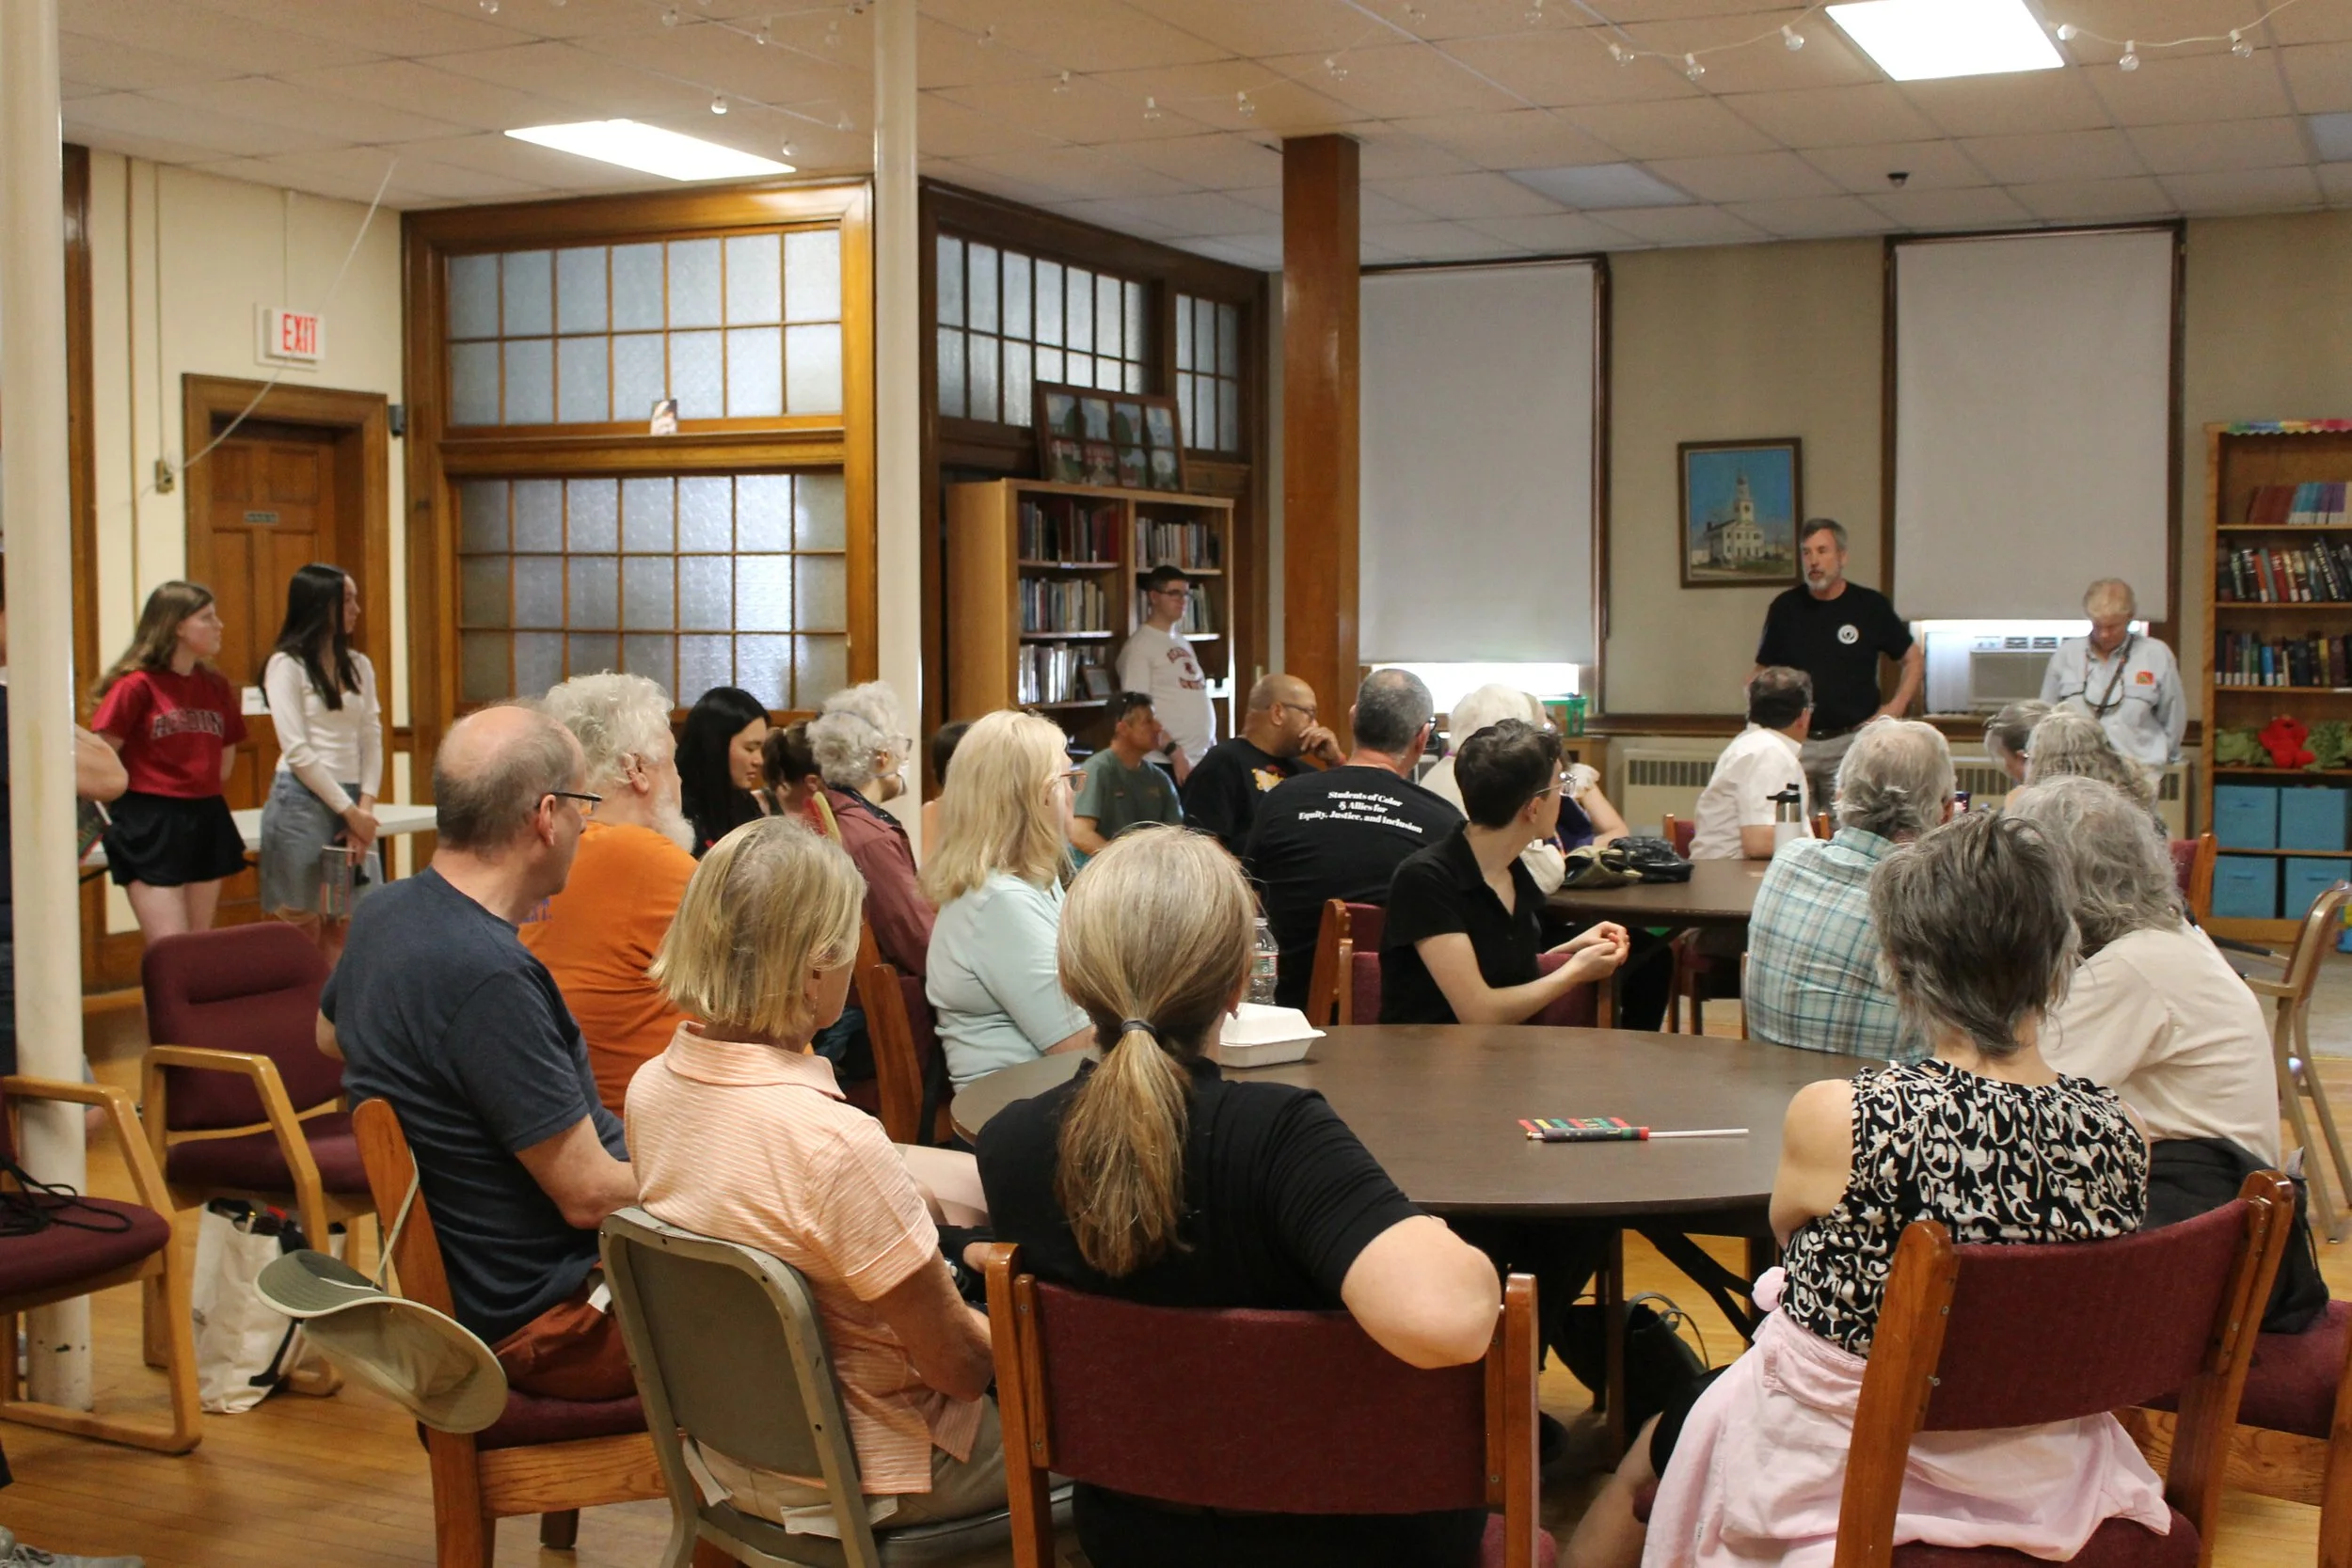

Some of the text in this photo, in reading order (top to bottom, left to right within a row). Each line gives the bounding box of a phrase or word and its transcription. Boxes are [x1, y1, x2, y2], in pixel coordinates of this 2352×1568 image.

[283, 313, 317, 354] EXIT
[1327, 791, 1367, 800] Students
[1377, 795, 1403, 806] Color
[1338, 801, 1388, 813] & Allies for
[1298, 811, 1422, 833] Equity, Justice, and Inclusion
